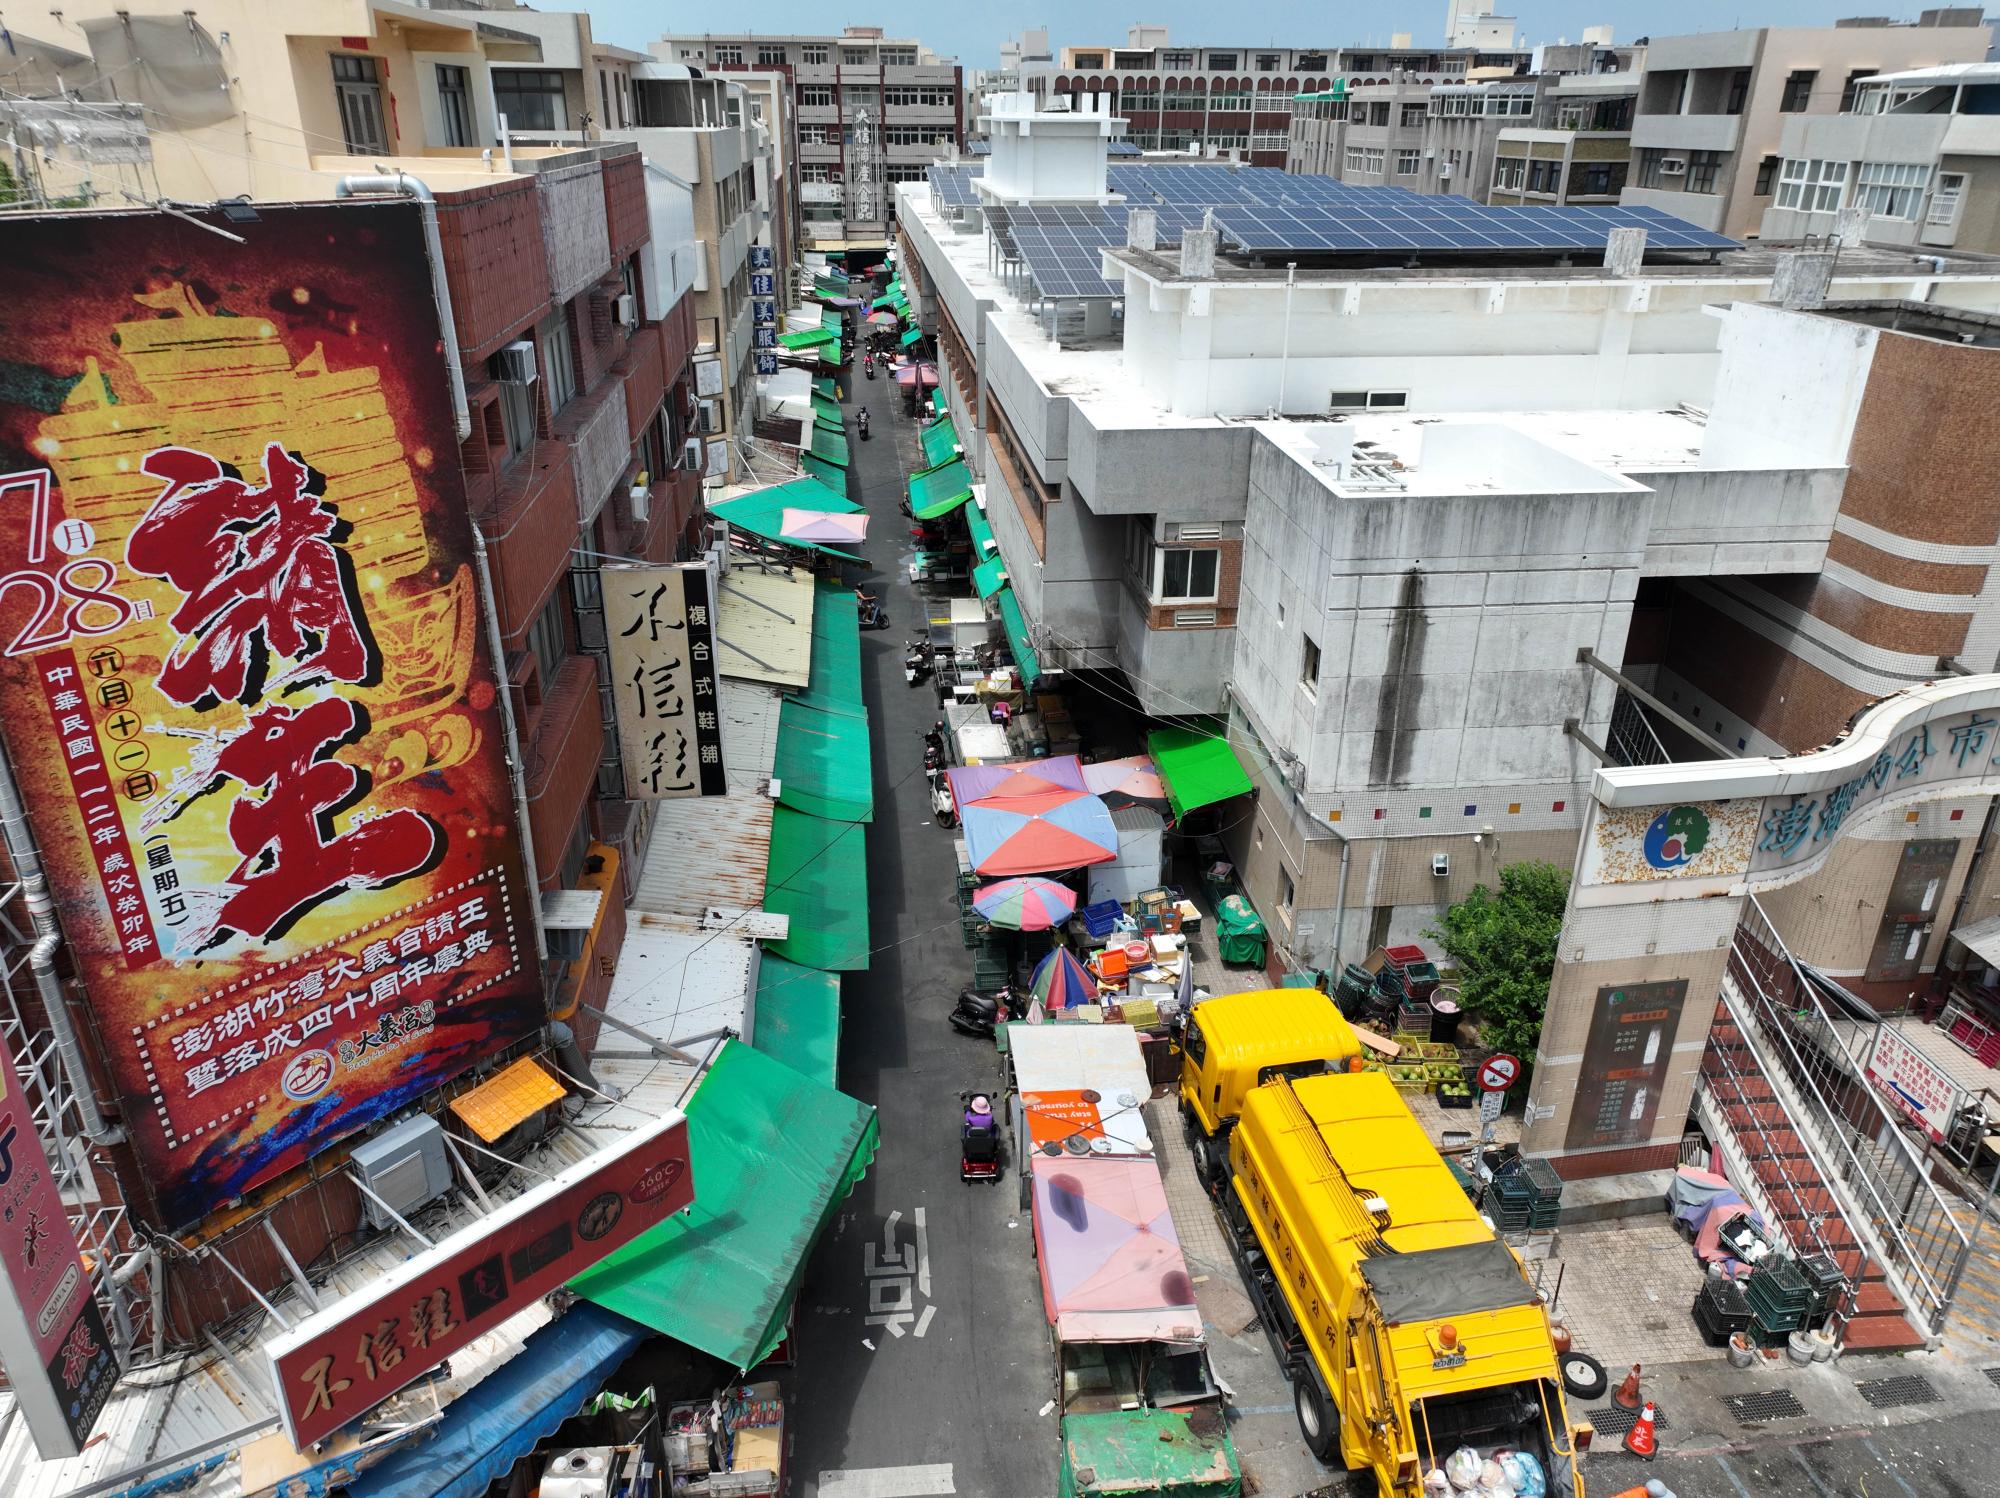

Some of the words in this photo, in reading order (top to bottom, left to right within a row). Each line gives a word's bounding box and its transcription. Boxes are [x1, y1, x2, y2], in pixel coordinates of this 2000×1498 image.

[751, 247, 777, 374] 美佳美服飾
[90, 648, 156, 800] 六月十一日
[688, 604, 719, 764] 複合式鞋舖
[170, 895, 489, 1062] 澎湖竹灣大義宮請王
[186, 928, 494, 1099] 暨落成四十周年慶典
[347, 1055, 370, 1071] Peng
[411, 1023, 434, 1039] Gong
[1032, 1100, 1075, 1111] yourself
[1070, 1110, 1092, 1118] stay
[864, 1206, 937, 1339] 停
